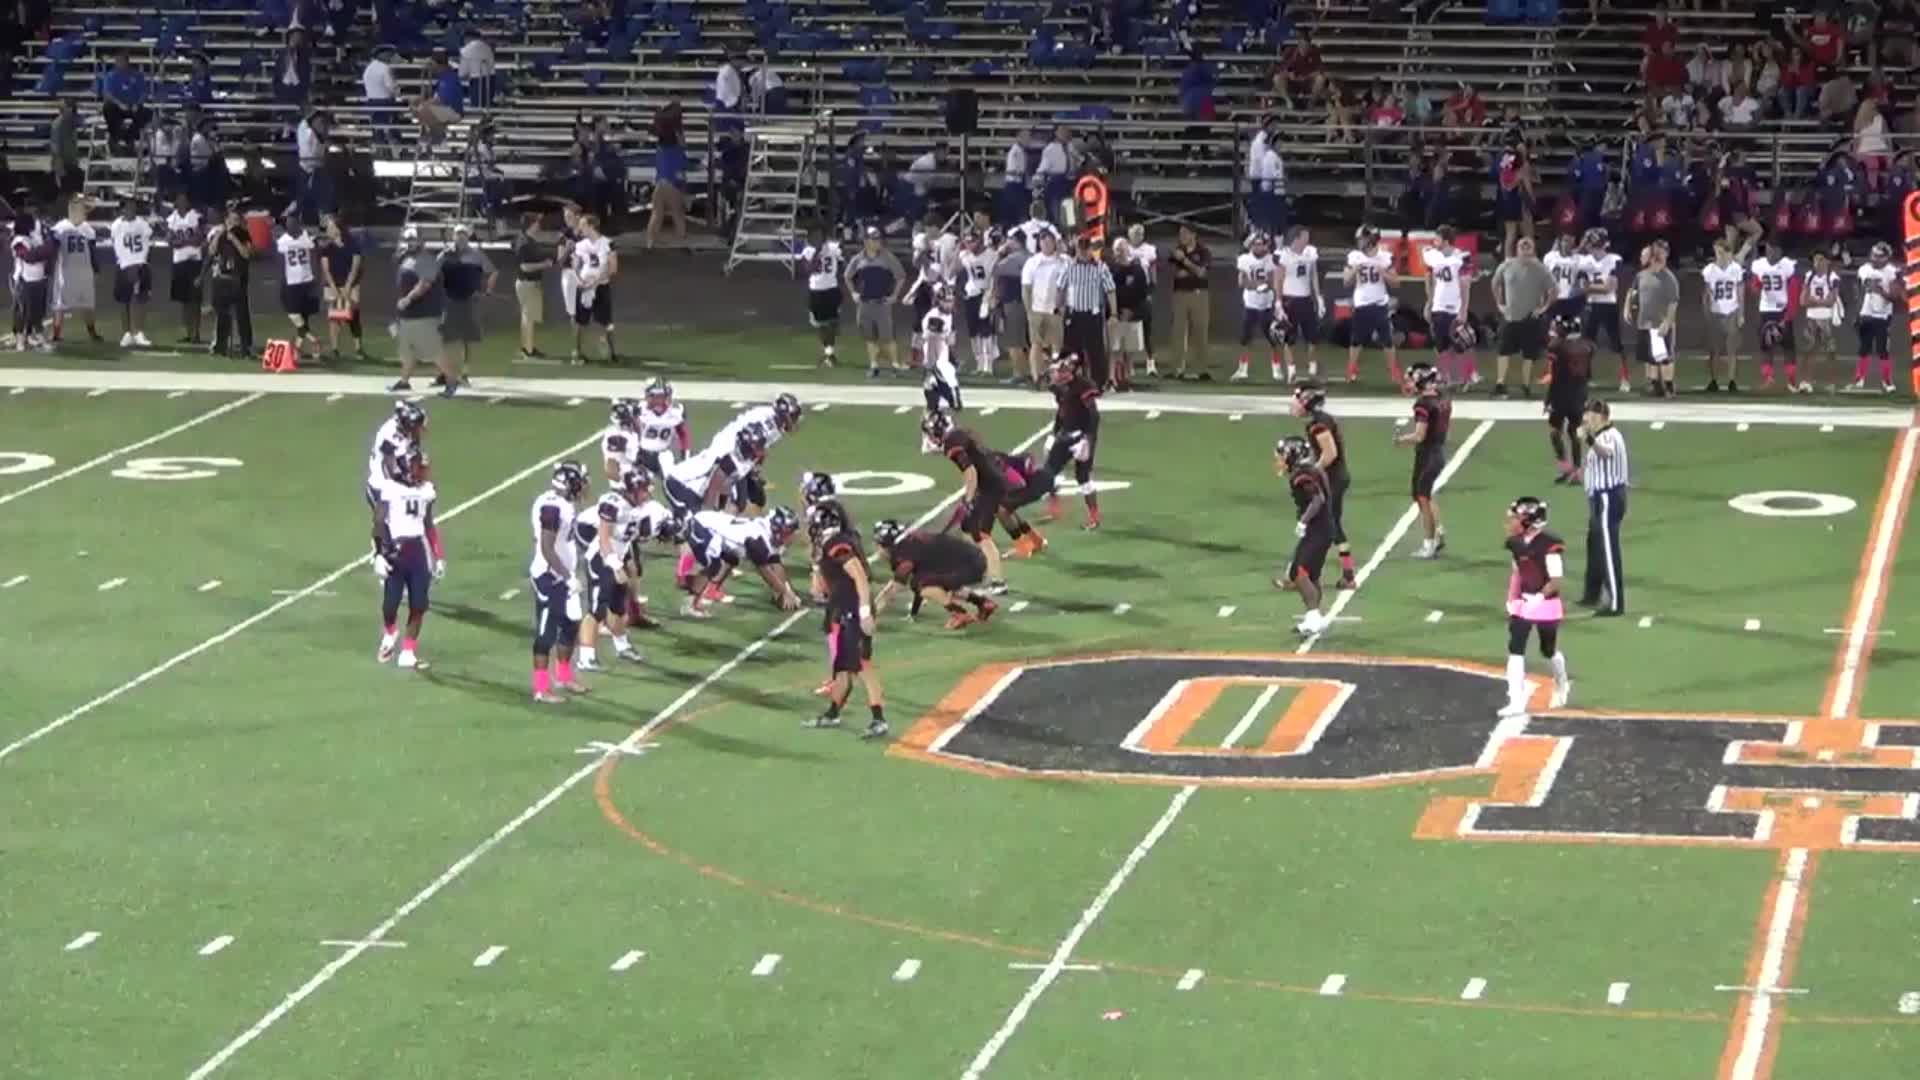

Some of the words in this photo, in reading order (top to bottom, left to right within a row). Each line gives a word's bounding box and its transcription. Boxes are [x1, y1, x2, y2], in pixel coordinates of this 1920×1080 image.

[123, 233, 143, 253] 45
[287, 250, 308, 267] 22
[1359, 266, 1381, 284] 56
[264, 342, 286, 368] 30
[405, 499, 419, 517] 4
